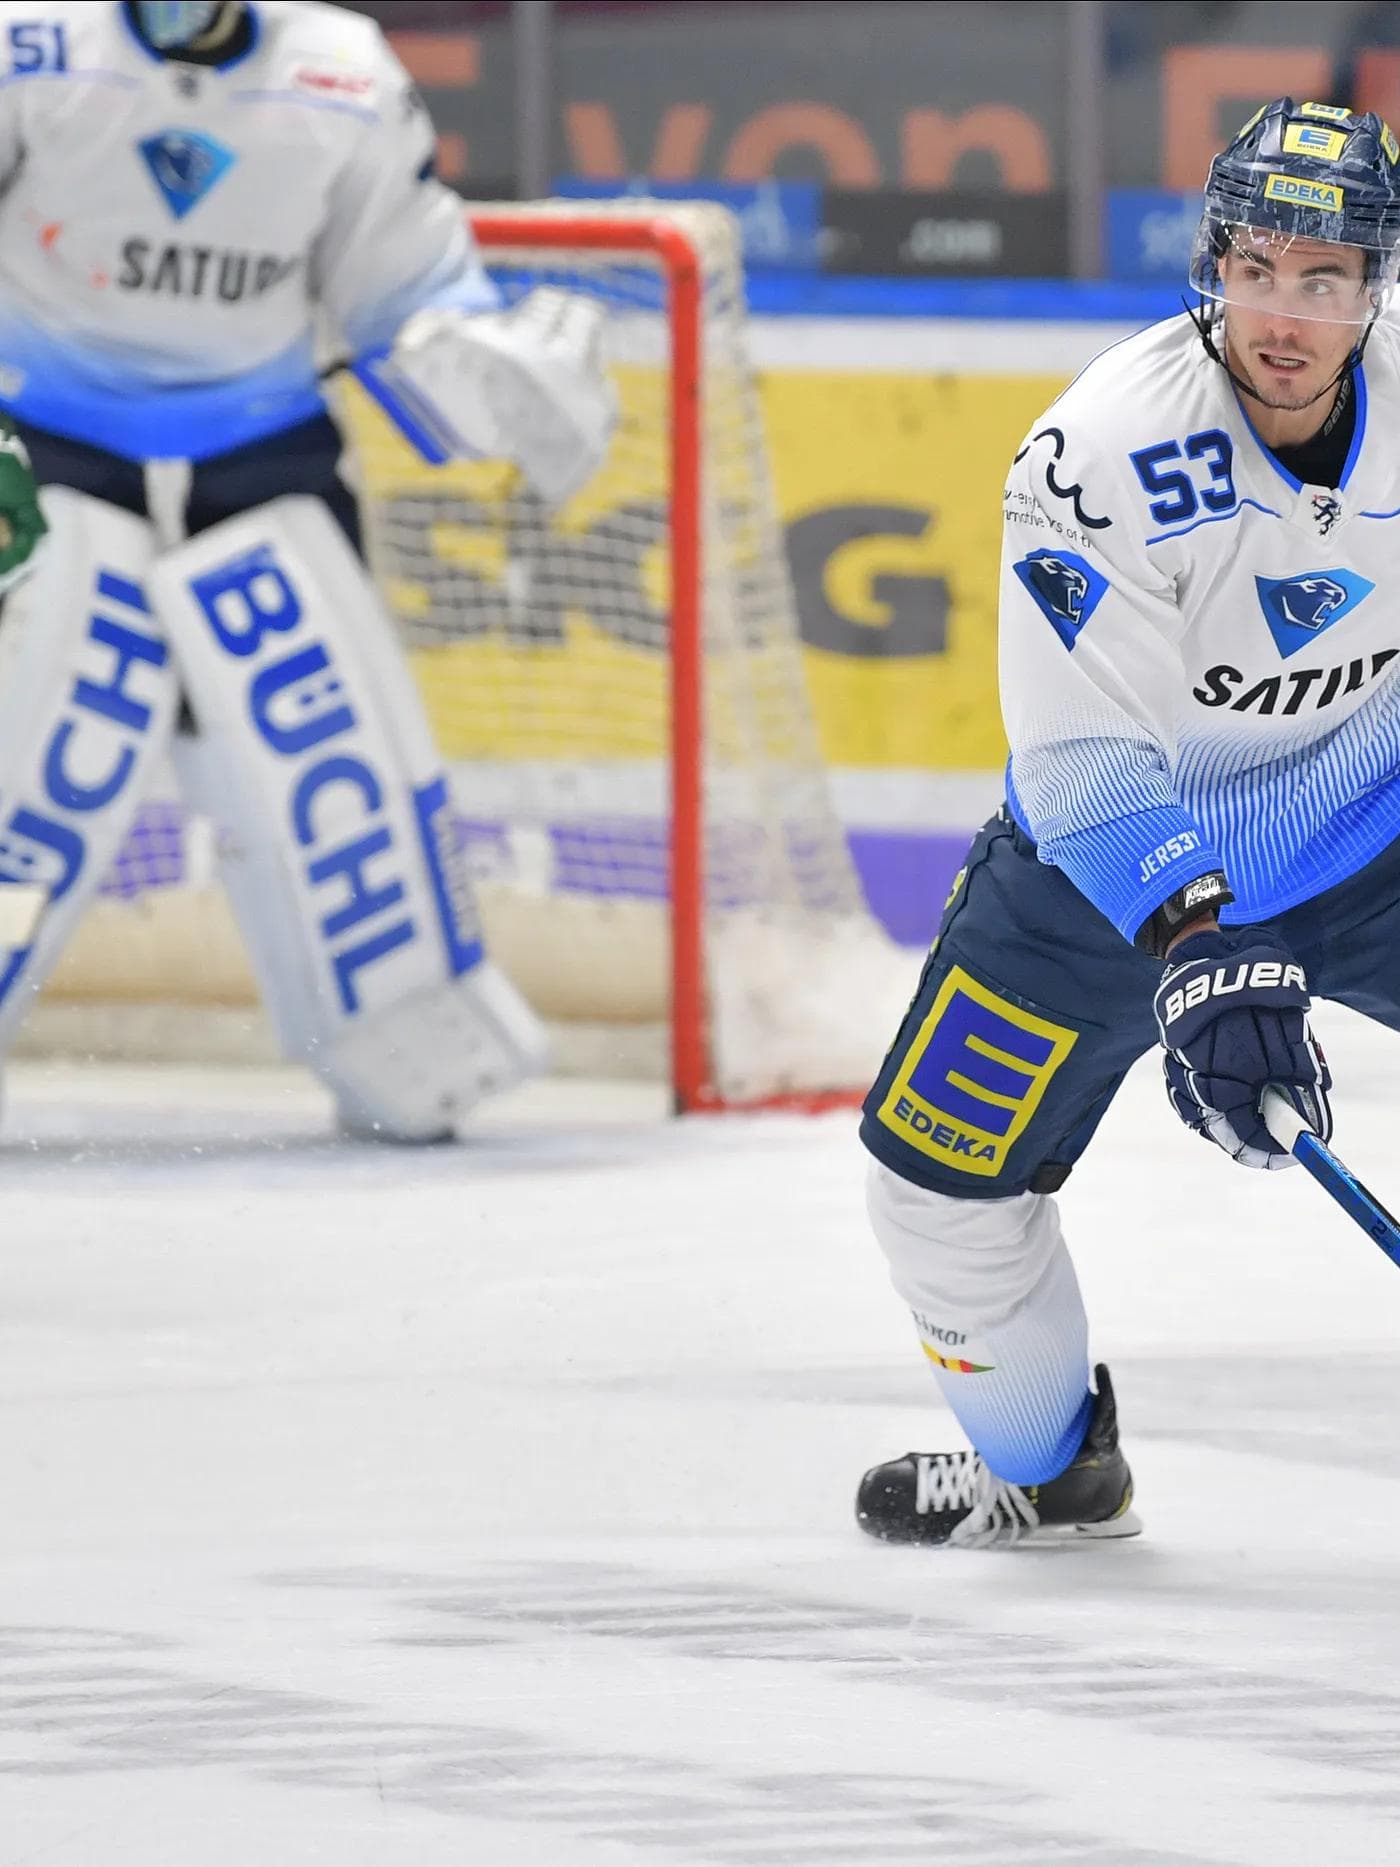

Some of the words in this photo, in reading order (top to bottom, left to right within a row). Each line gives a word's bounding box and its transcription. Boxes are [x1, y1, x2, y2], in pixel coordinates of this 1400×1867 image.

[9, 22, 67, 74] 51
[1271, 179, 1337, 202] EDEKA
[1129, 428, 1236, 526] 53
[188, 543, 417, 1016] BÜCHL
[893, 1098, 997, 1162] EDEKA
